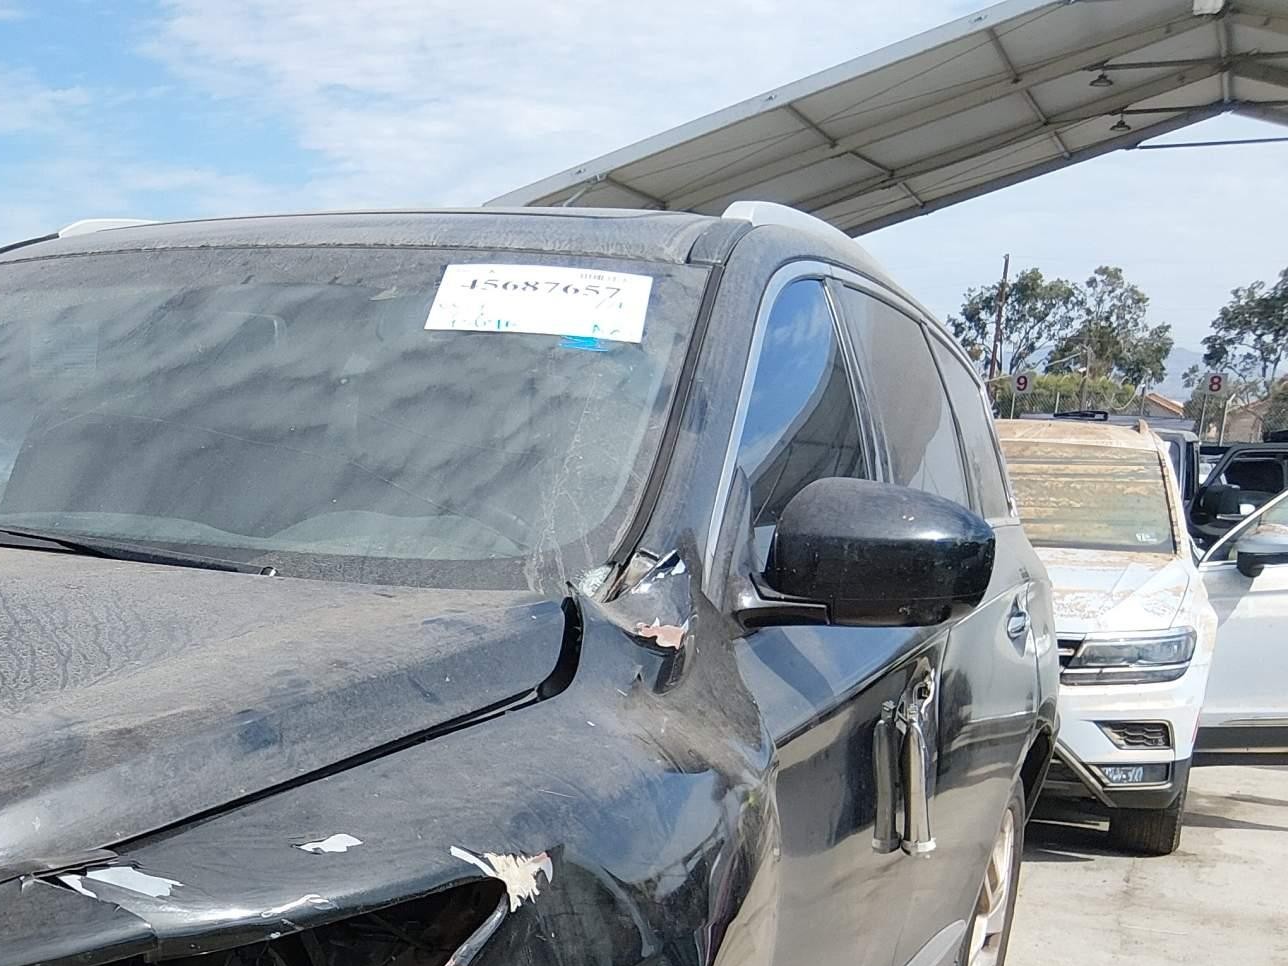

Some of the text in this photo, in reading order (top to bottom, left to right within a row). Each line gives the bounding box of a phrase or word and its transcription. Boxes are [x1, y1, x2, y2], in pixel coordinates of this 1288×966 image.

[460, 278, 621, 298] 45687657
[1016, 375, 1028, 391] 9
[1208, 375, 1222, 392] 8
